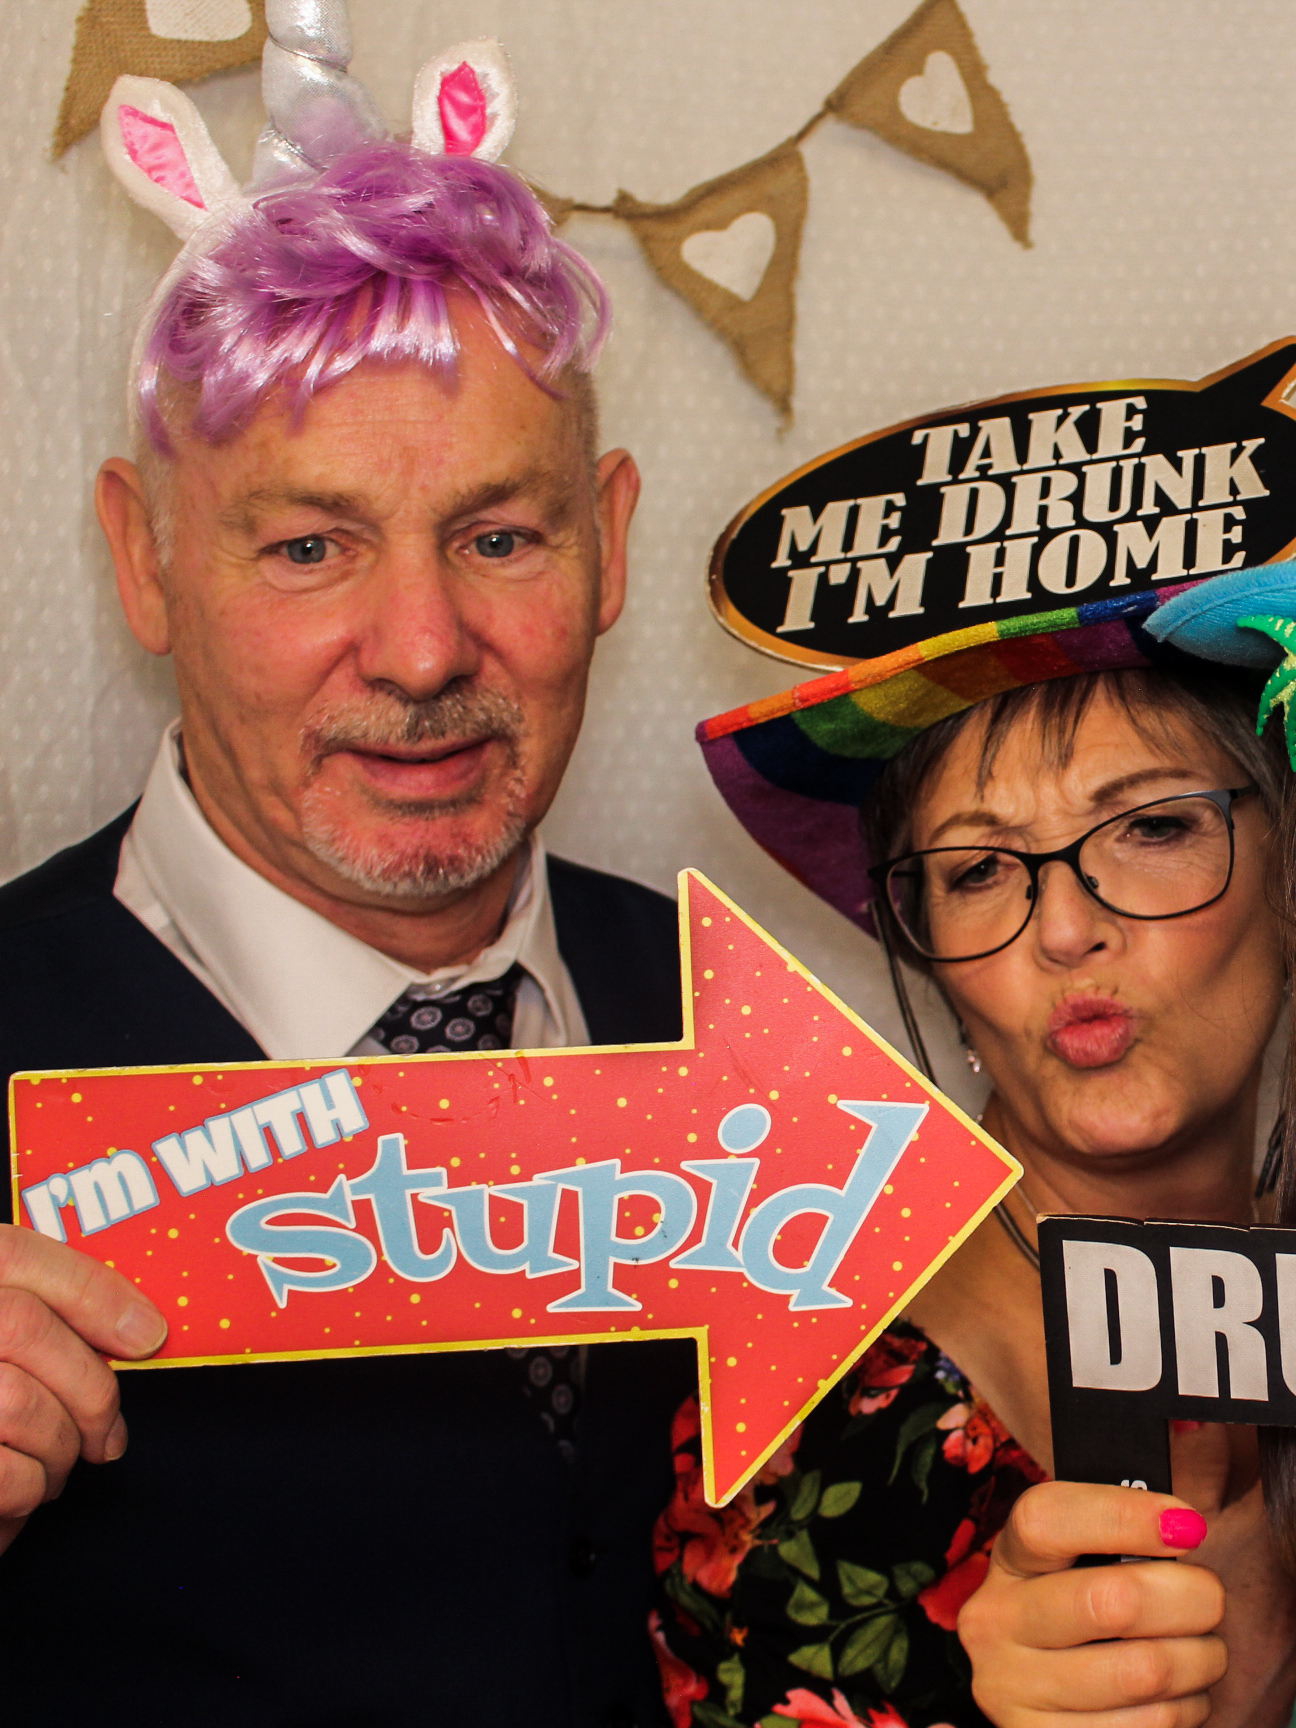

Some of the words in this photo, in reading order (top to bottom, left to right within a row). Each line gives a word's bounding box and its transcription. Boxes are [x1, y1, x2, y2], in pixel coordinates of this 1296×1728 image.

[770, 492, 906, 569] ME
[931, 437, 1270, 547] DRUNK
[912, 395, 1148, 486] TAKE
[776, 552, 933, 633] I'M
[958, 505, 1249, 610] HOME
[151, 1068, 370, 1197] WITH
[225, 1100, 930, 1313] stupid
